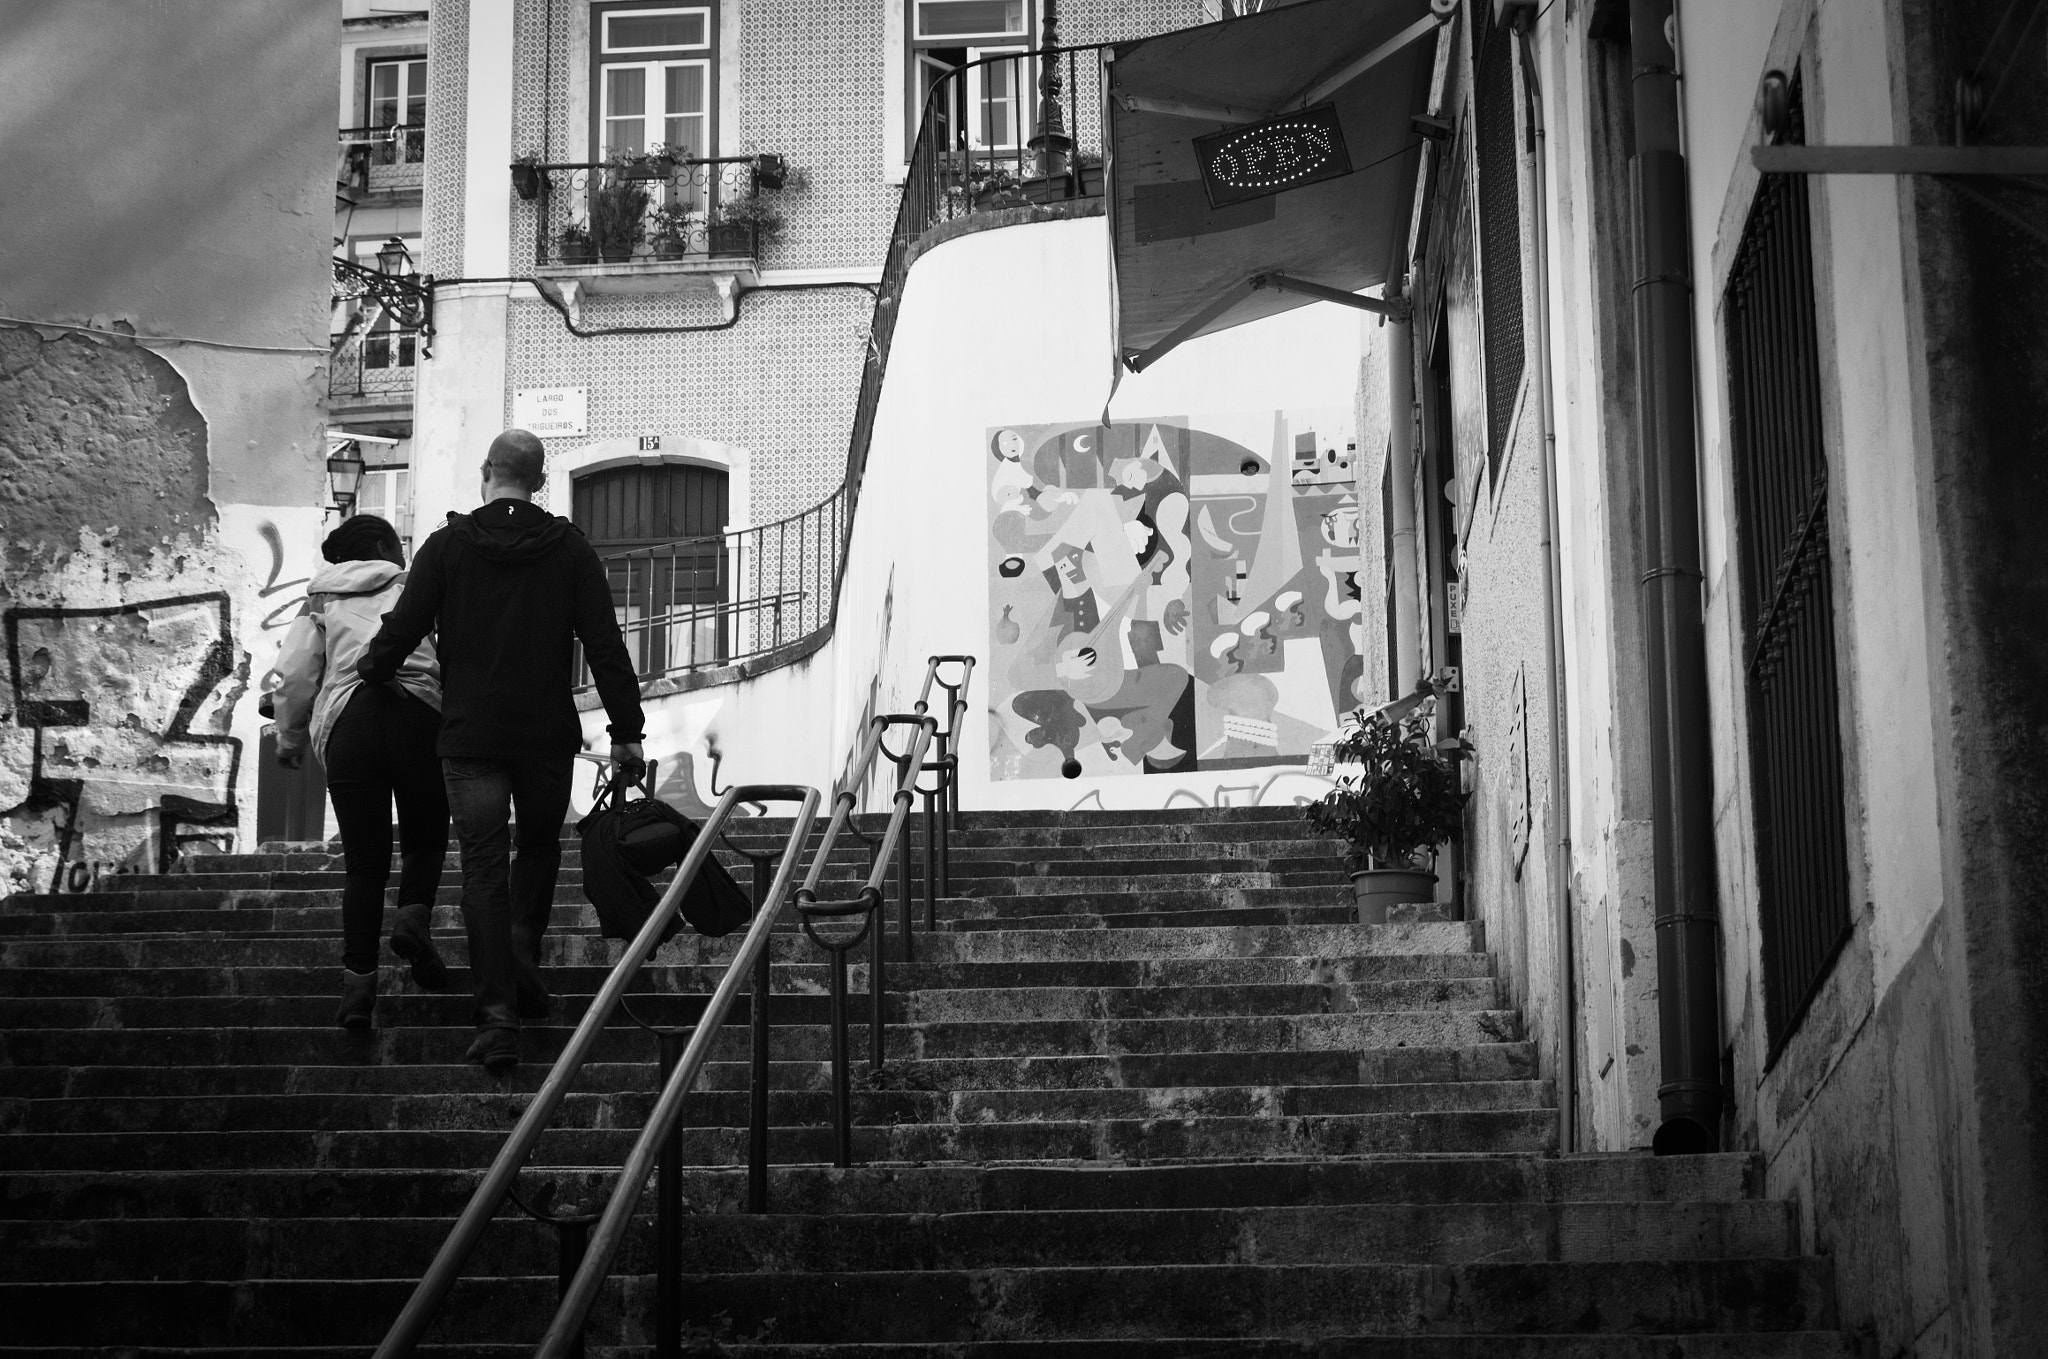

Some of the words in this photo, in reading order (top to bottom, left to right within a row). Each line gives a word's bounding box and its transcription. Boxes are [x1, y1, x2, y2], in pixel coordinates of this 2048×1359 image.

[1211, 127, 1332, 180] OPEN
[536, 394, 564, 403] LARGO
[542, 408, 558, 416] DOS
[1449, 585, 1458, 618] PUXE
